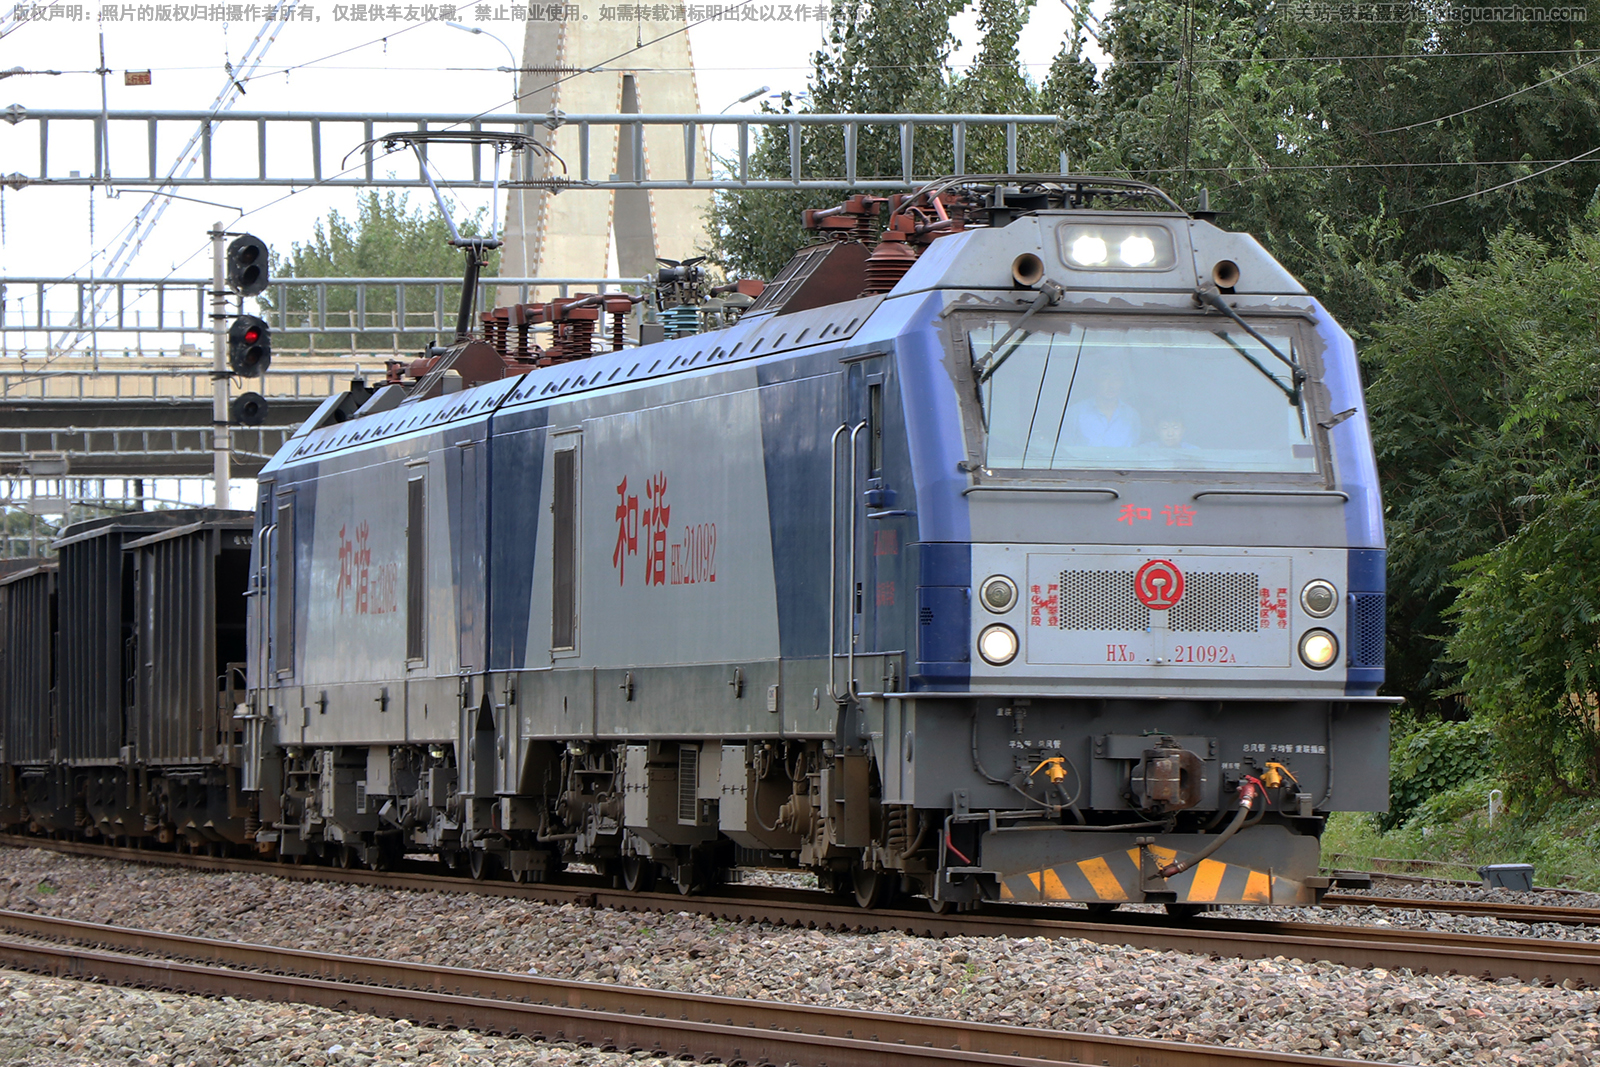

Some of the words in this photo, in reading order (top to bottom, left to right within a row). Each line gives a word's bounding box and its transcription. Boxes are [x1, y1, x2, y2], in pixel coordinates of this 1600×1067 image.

[612, 470, 670, 587] 和谐
[1117, 503, 1197, 527] 和谐
[336, 519, 371, 616] 和谐
[1106, 644, 1136, 662] HXD
[1174, 645, 1237, 664] 21092A
